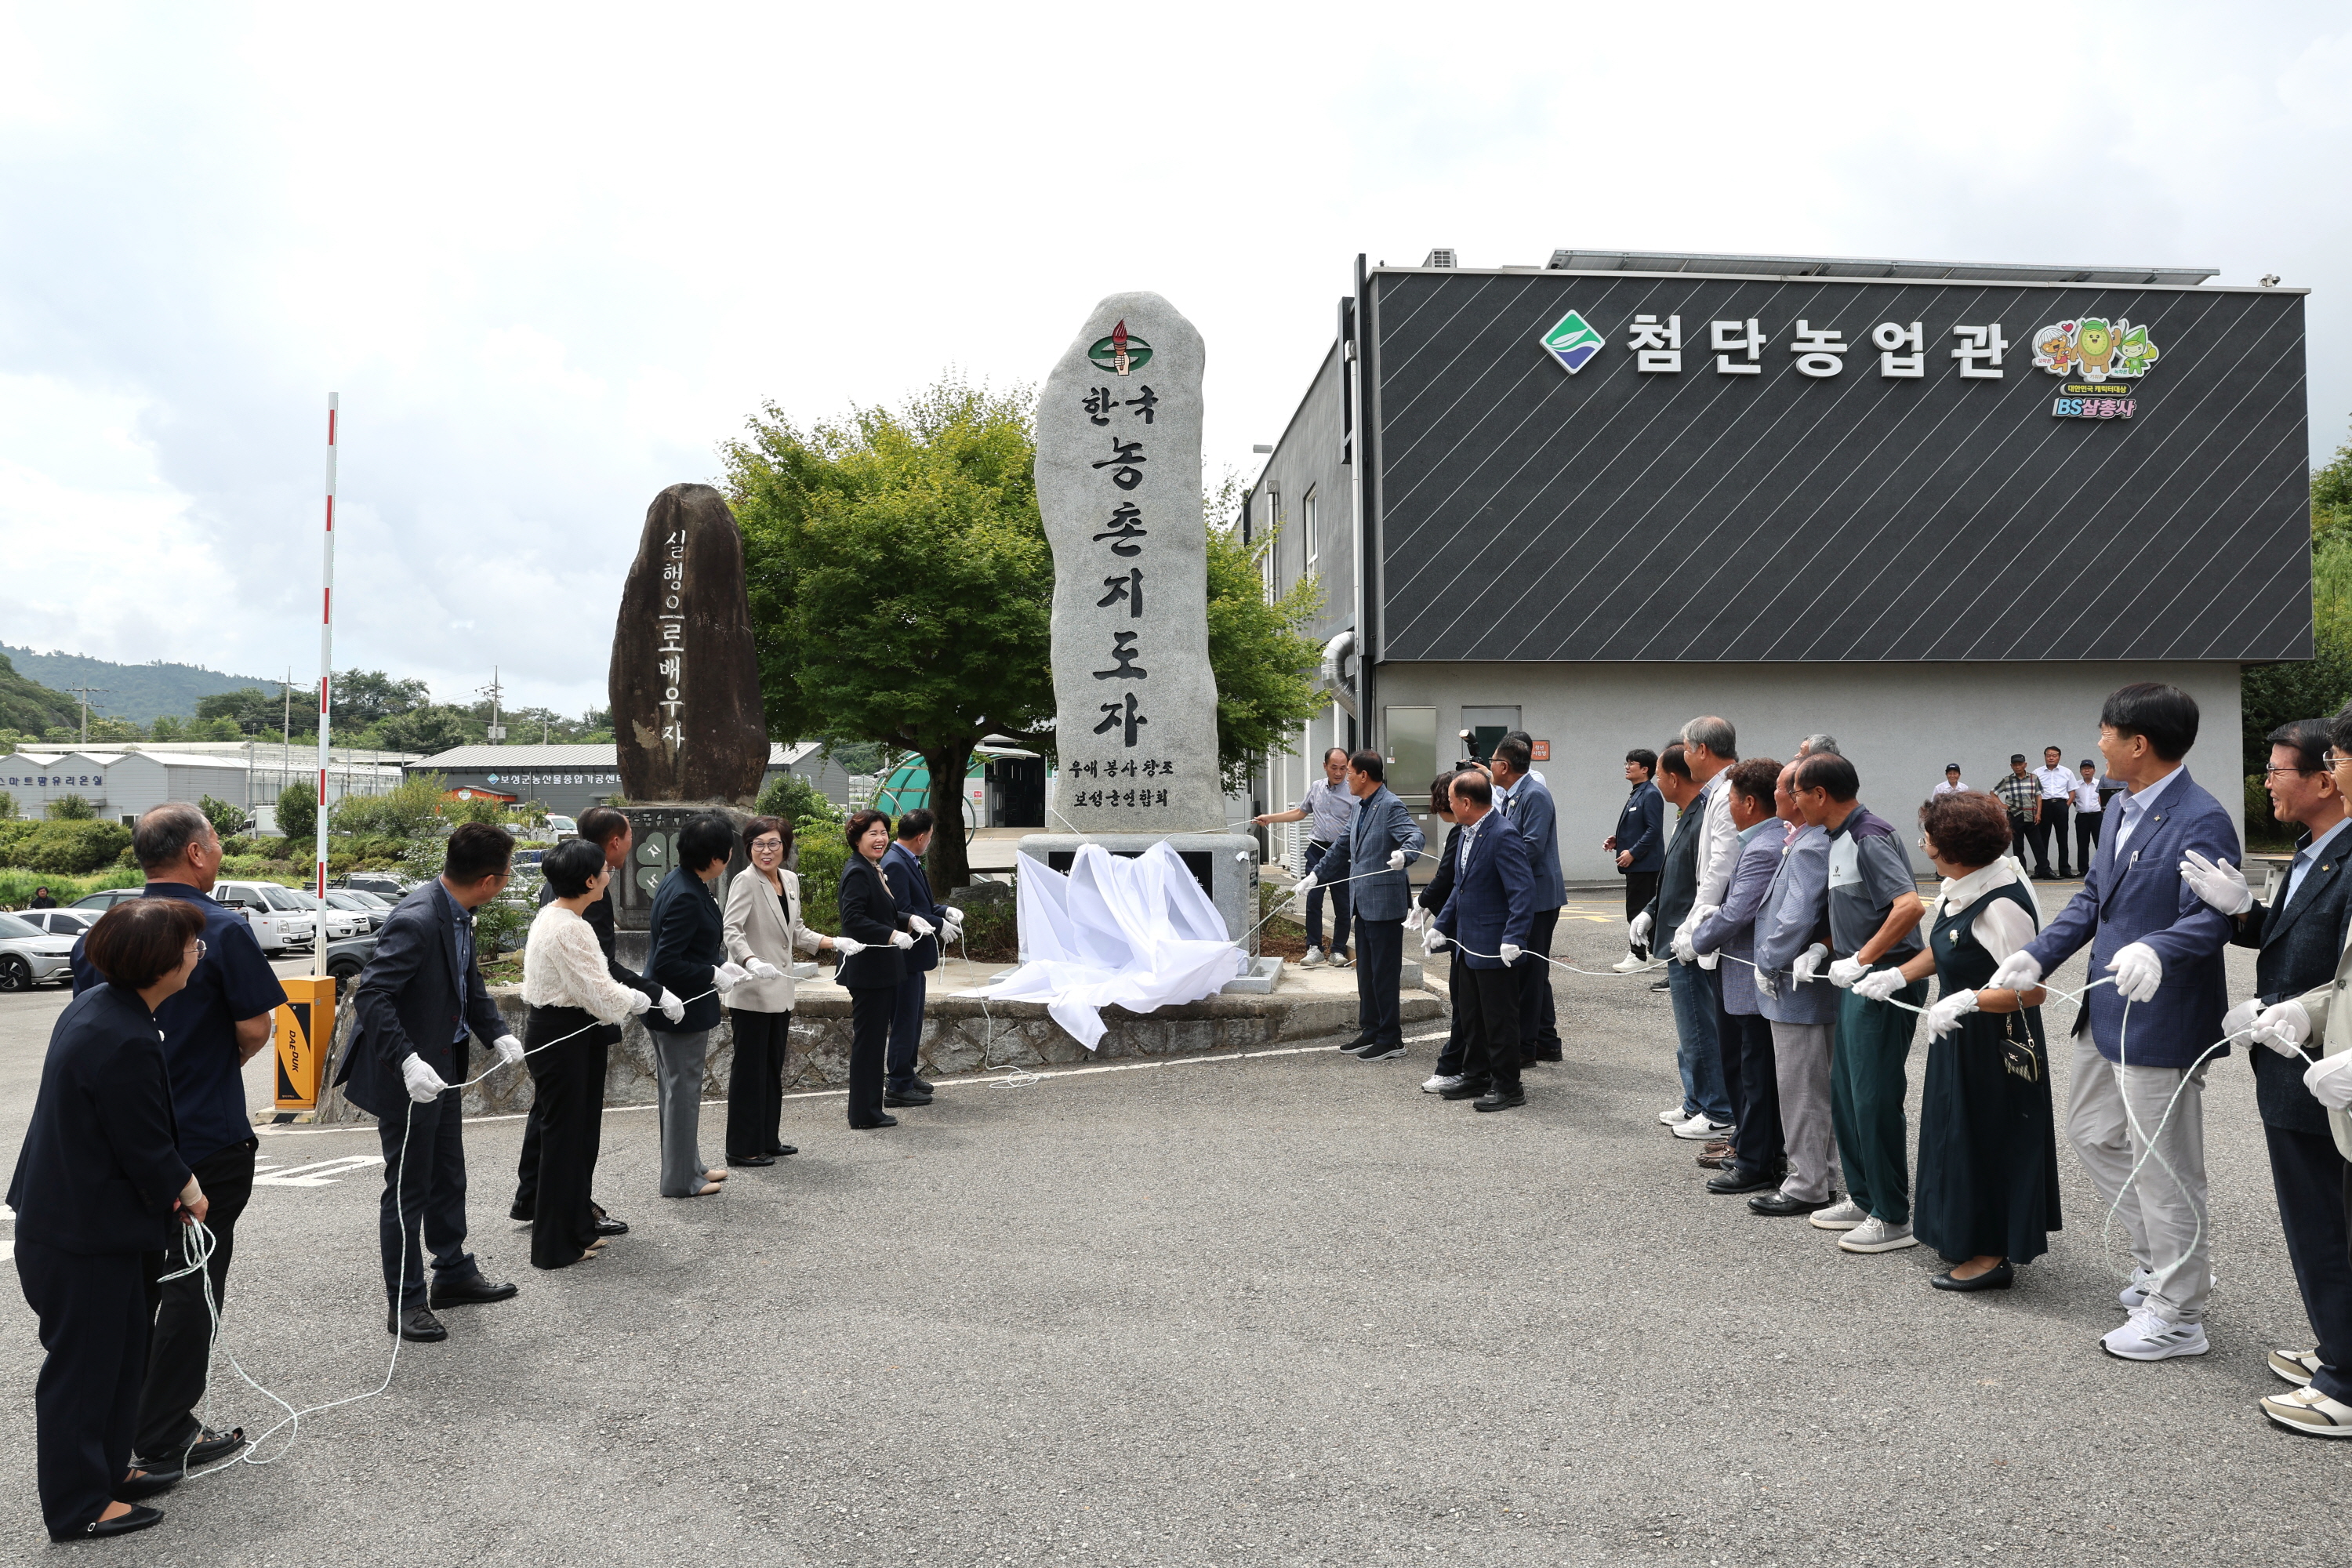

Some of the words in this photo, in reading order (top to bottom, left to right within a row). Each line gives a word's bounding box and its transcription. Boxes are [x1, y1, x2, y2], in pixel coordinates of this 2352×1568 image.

[1626, 314, 2008, 379] 첨단농업관
[2094, 385, 2127, 394] 캐릭터대상
[1081, 385, 1159, 426] 한국
[2057, 398, 2136, 417] BS삼총사
[1092, 437, 1148, 748] 농촌지도자
[1069, 760, 1098, 779] 우애
[1104, 759, 1138, 778] 봉사
[1142, 759, 1174, 778] 창조
[647, 844, 662, 858] 지
[289, 1029, 299, 1073] DAEDUK
